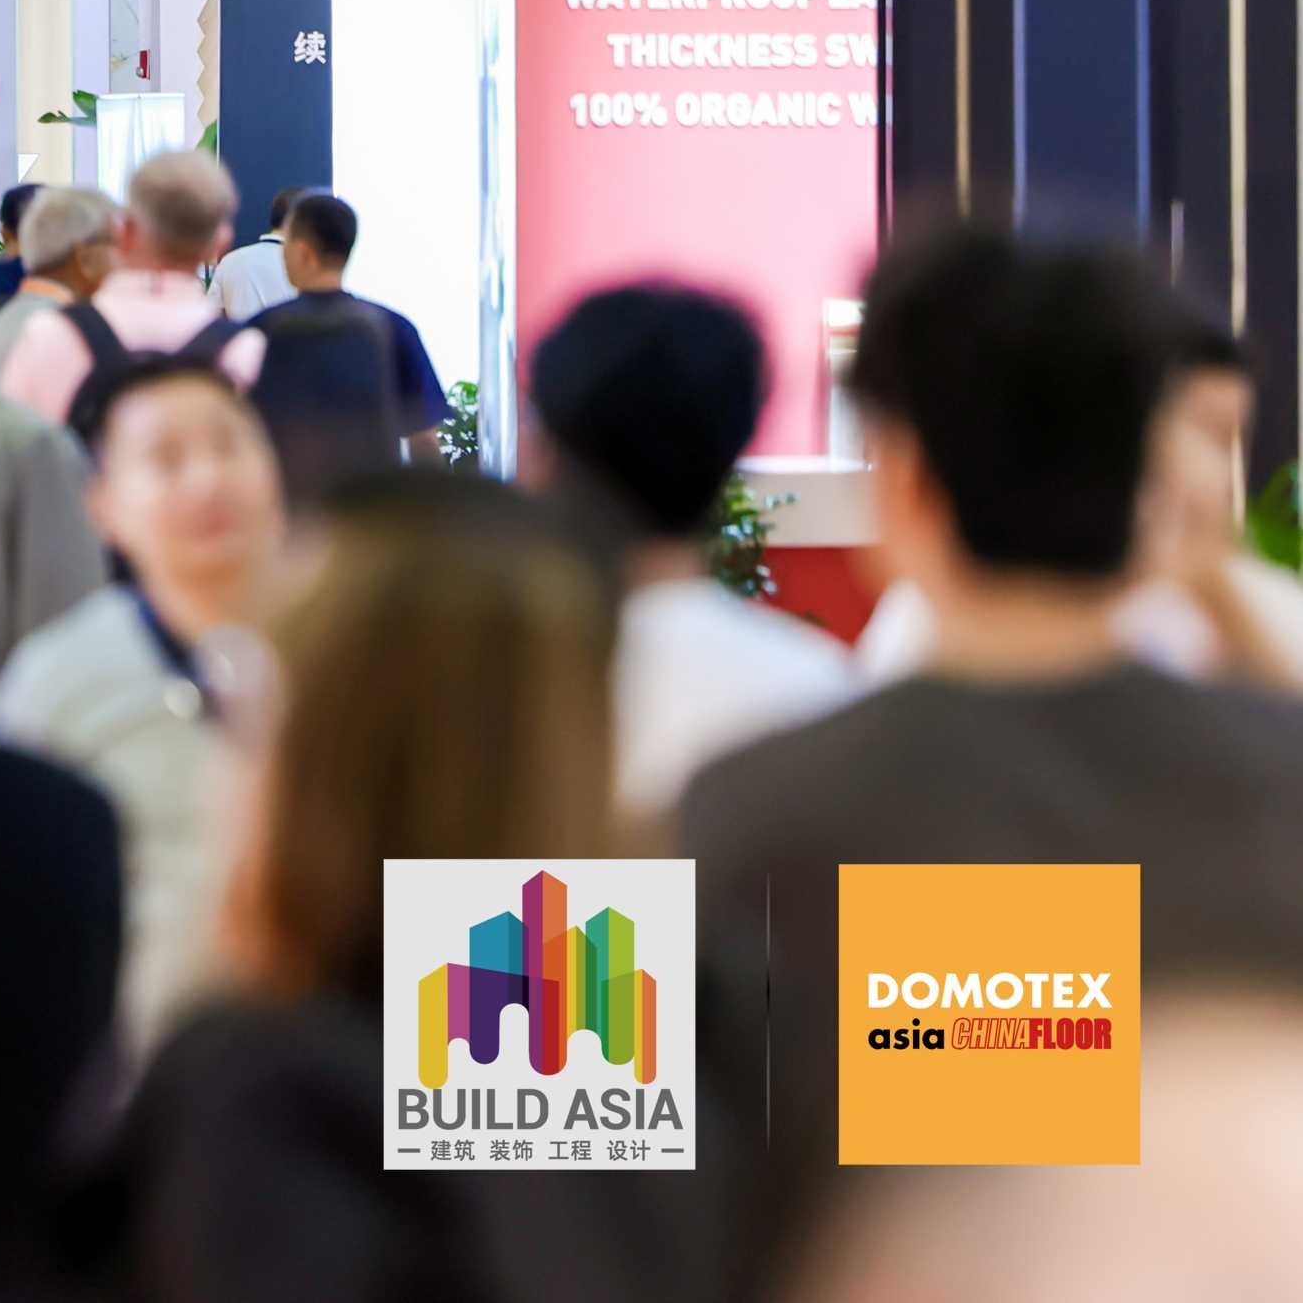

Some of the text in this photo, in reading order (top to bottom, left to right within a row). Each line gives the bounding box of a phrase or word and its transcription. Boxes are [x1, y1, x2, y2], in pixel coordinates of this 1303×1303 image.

[606, 33, 818, 68] THICKNESS
[570, 92, 668, 127] 100%
[675, 92, 842, 127] ORGANIC
